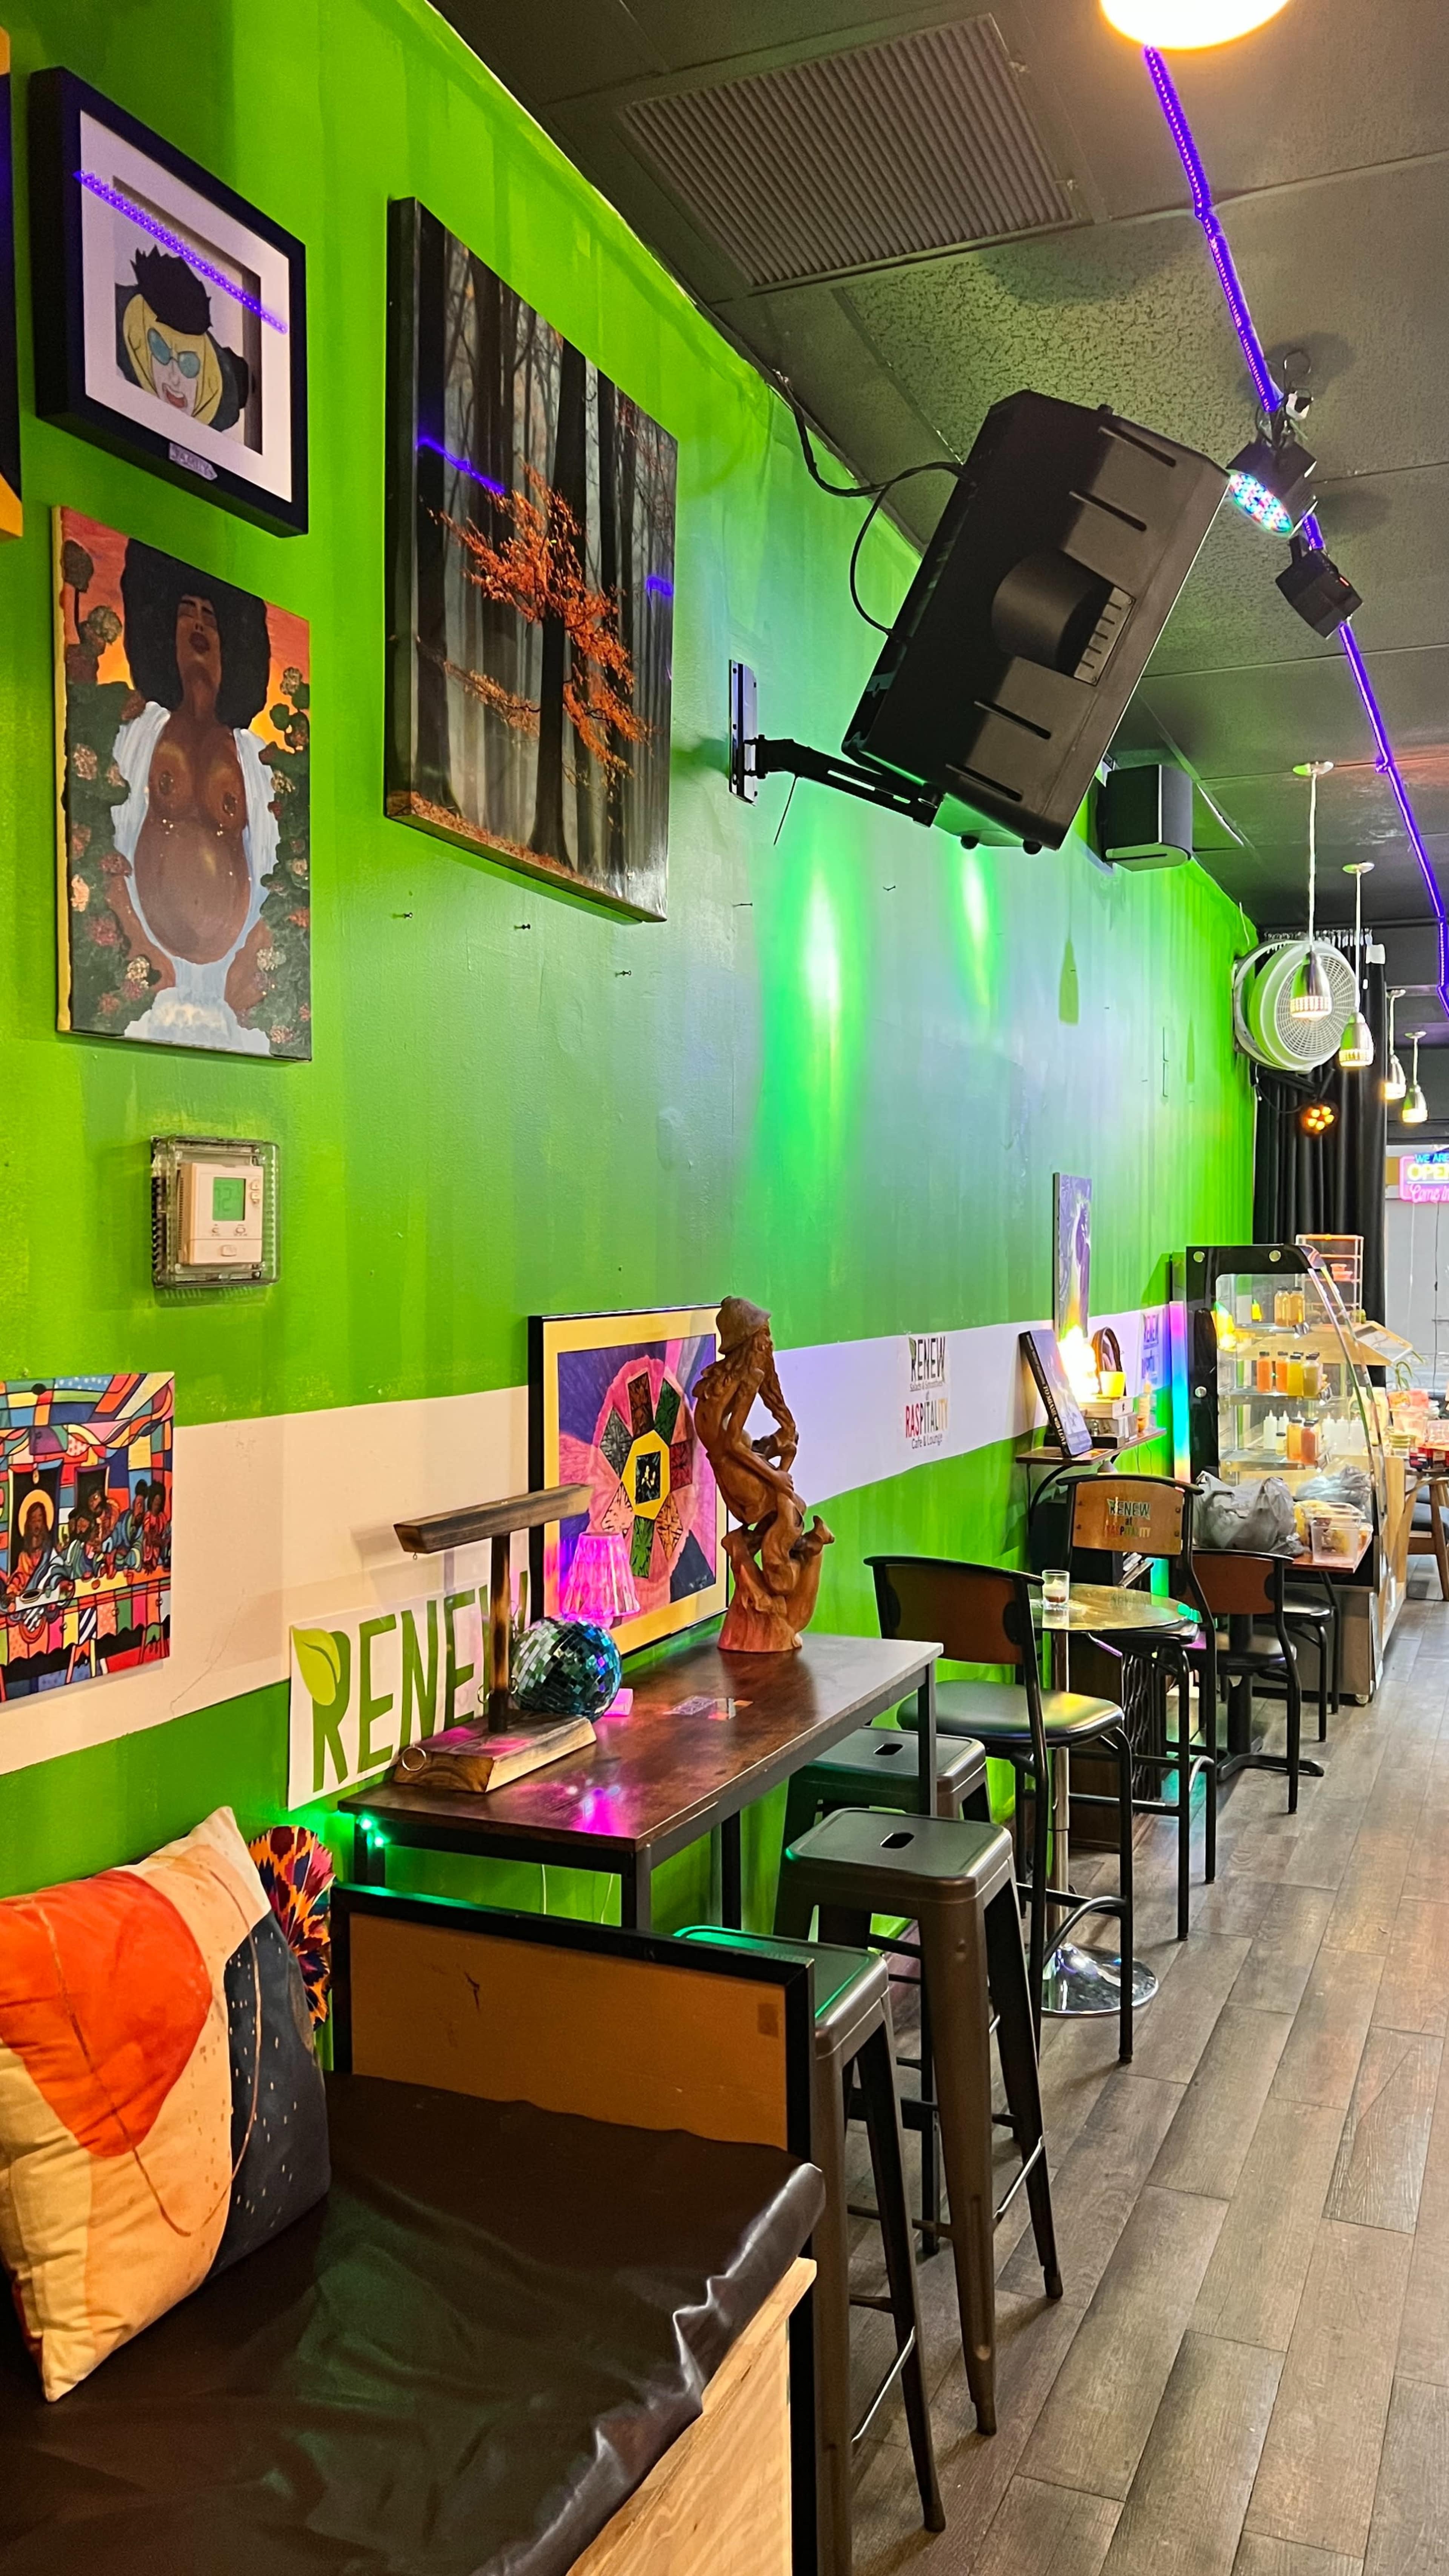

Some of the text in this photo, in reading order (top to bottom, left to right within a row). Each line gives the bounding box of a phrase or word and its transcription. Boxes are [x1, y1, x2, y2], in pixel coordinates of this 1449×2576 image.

[1415, 1153, 1430, 1163] WE
[1407, 1163, 1449, 1180] OPE
[1410, 1184, 1440, 1203] Come
[909, 1336, 945, 1382] RENEW
[906, 1399, 948, 1438] RASPITALITY
[1109, 1501, 1150, 1517] RENEW
[1125, 1517, 1132, 1526] at
